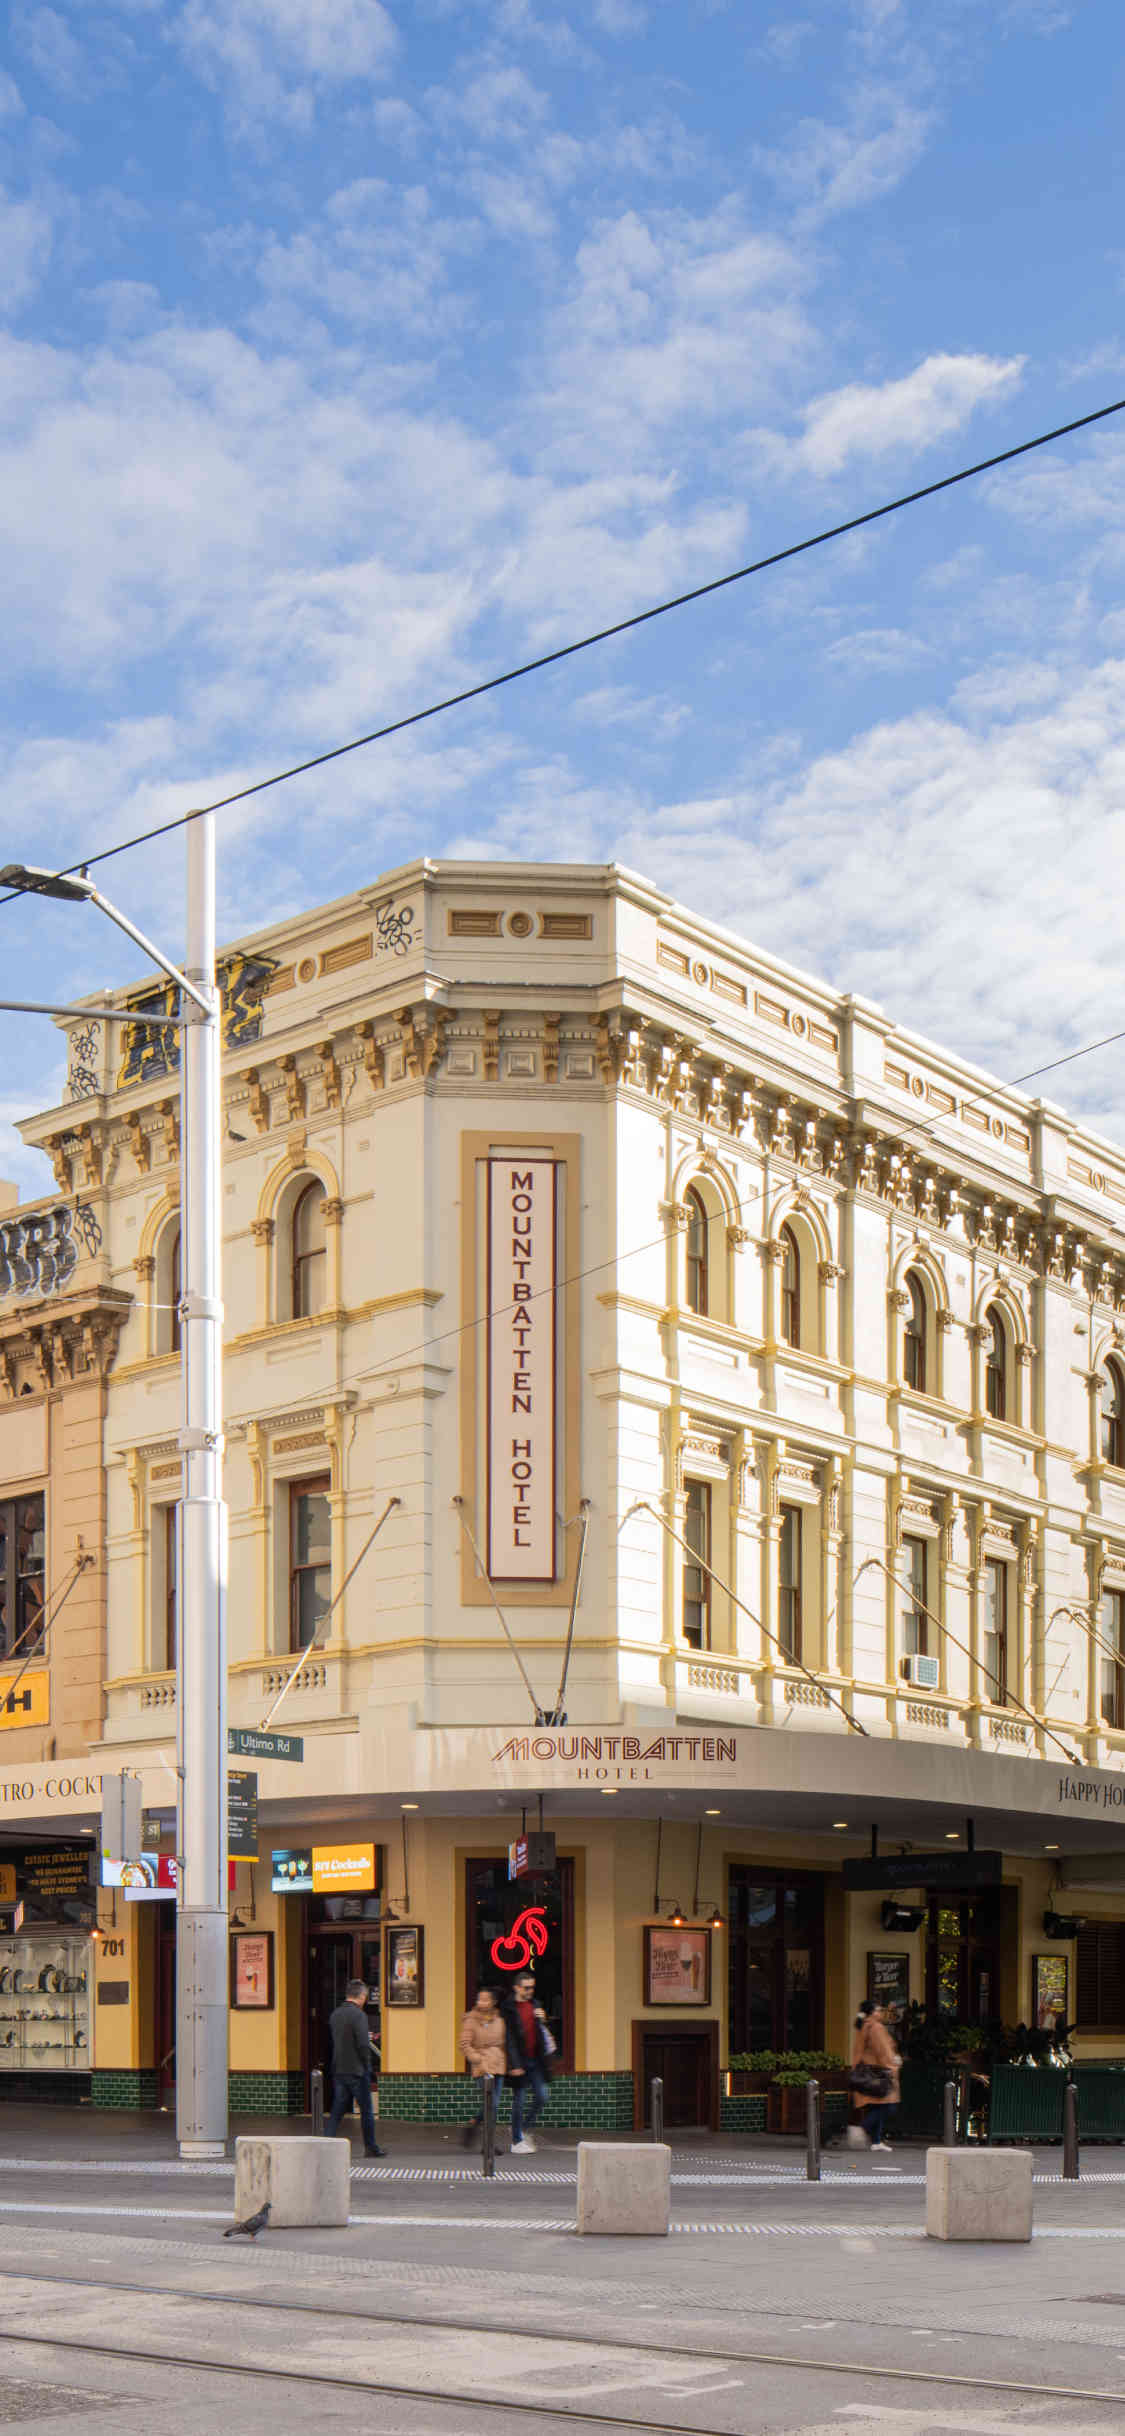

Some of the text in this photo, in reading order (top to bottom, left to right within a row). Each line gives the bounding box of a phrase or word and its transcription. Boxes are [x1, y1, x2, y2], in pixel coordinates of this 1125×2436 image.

[511, 1171, 533, 1547] MOUNTBATTEN HOTEL
[0, 1689, 32, 1712] H
[240, 1735, 274, 1751] Ultimo
[277, 1739, 291, 1752] Rd
[491, 1736, 736, 1761] MOUNTBATTEN
[577, 1768, 653, 1780] HOTEL
[101, 1939, 124, 1957] 701
